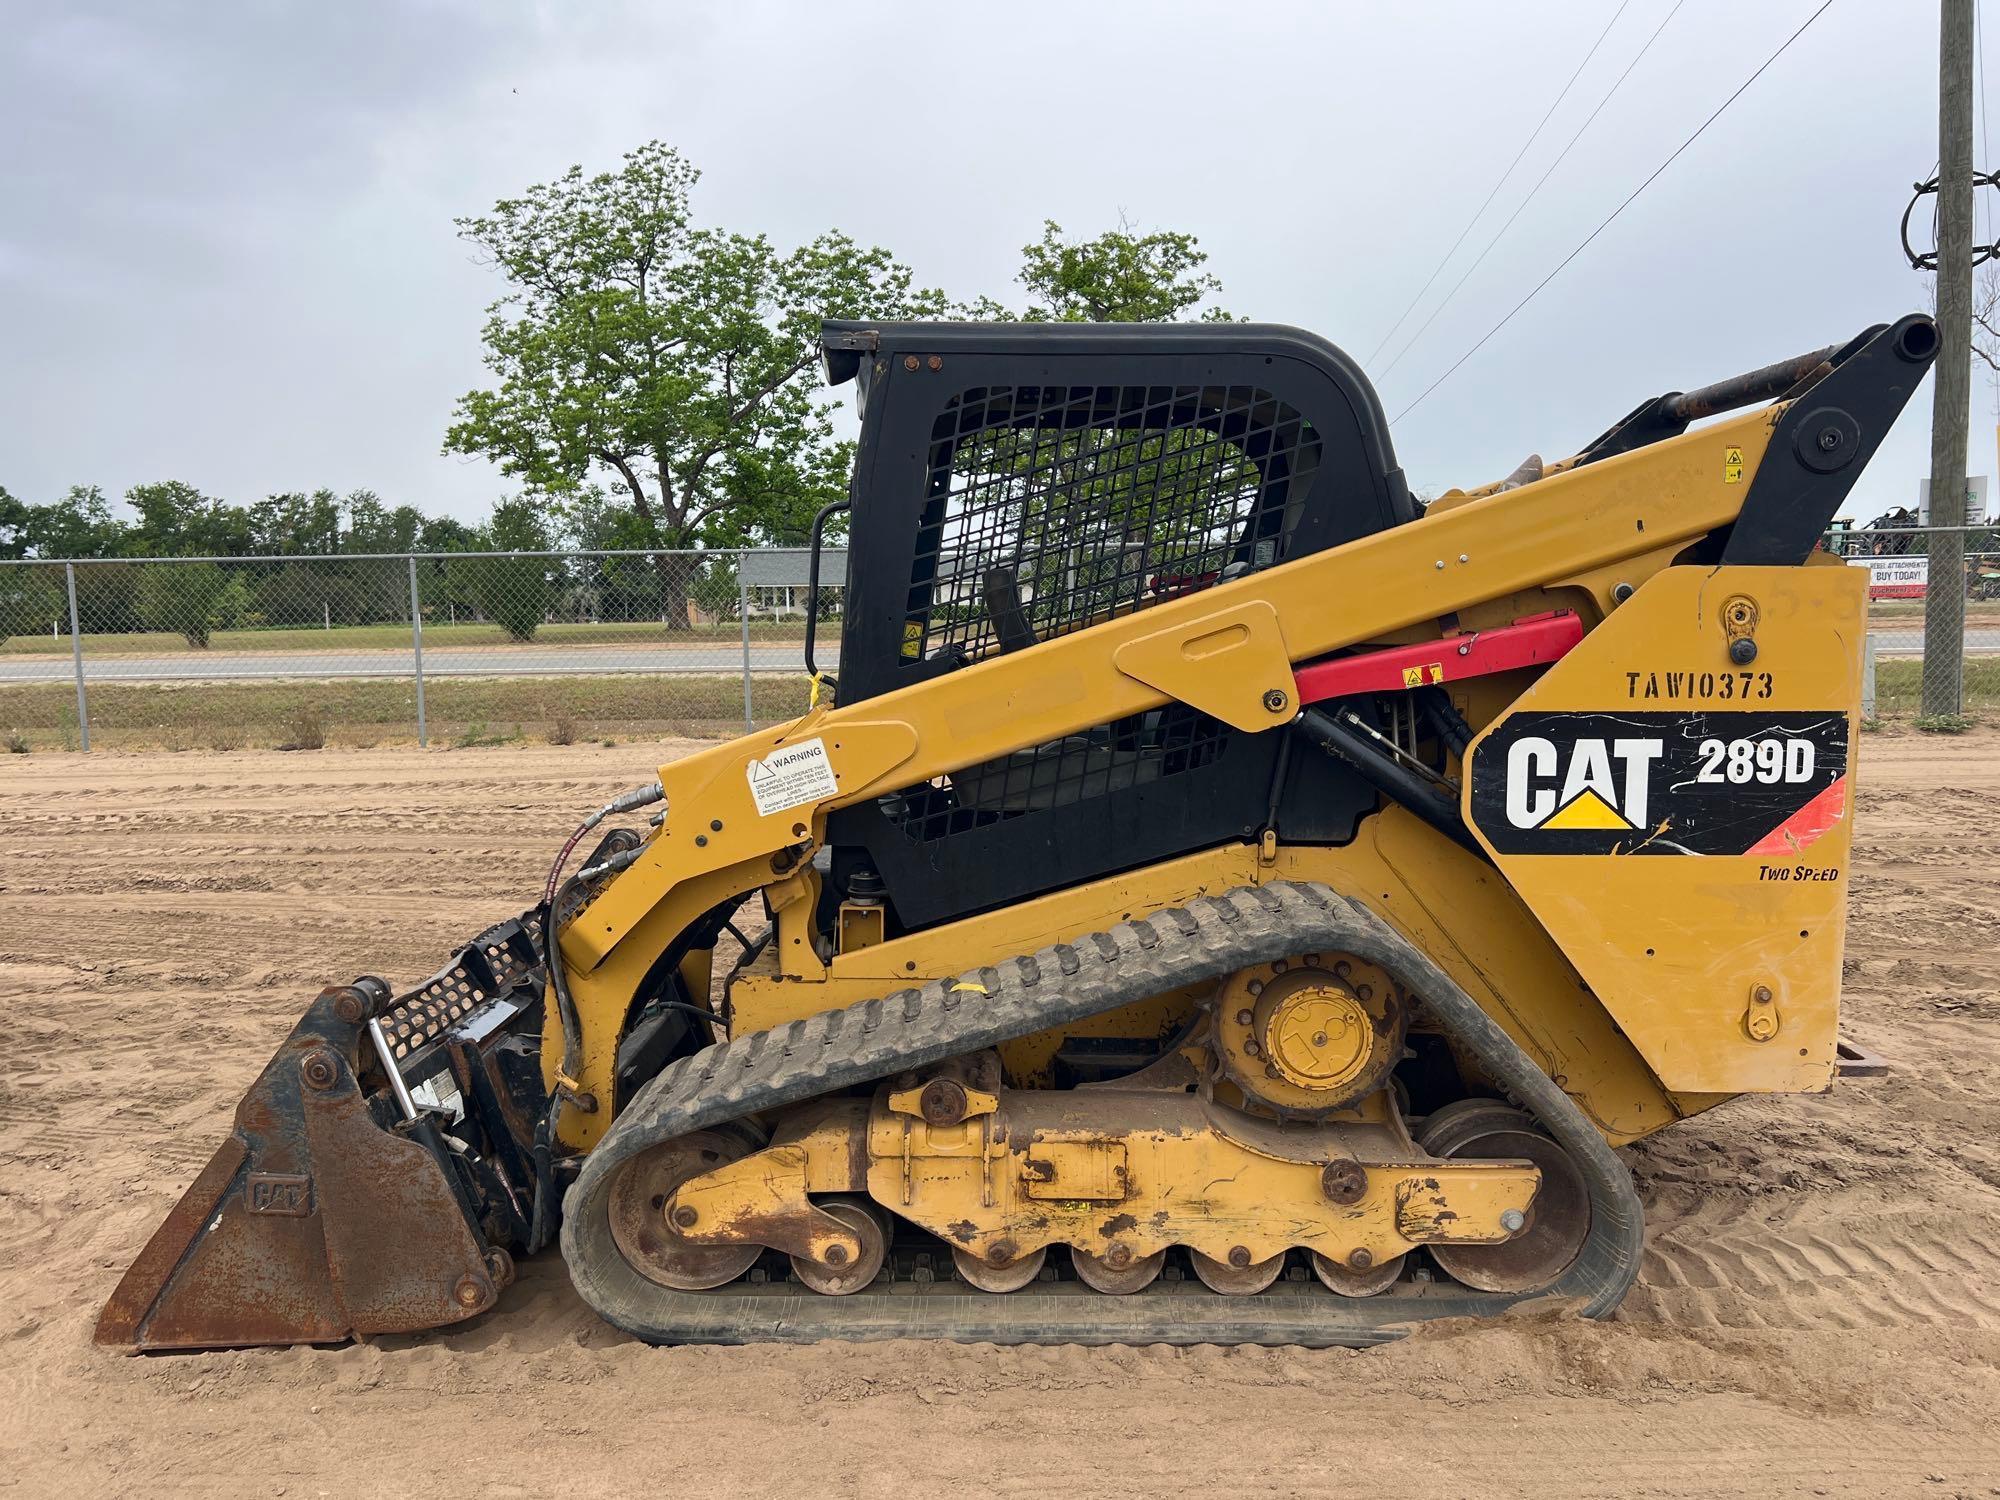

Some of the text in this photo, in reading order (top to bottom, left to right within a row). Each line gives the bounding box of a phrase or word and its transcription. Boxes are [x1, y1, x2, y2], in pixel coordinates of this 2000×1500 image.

[1876, 571, 1920, 581] BUY TODAY!
[773, 747, 821, 768] WARNING
[756, 778, 782, 789] UNLAWFUL
[791, 769, 813, 778] OPERATE
[757, 782, 785, 794] EQUIPMENT
[787, 777, 804, 785] WITHIN
[1506, 736, 1816, 830] CAT 289D
[767, 786, 793, 797] OVERHEAD
[765, 799, 782, 808] Contact
